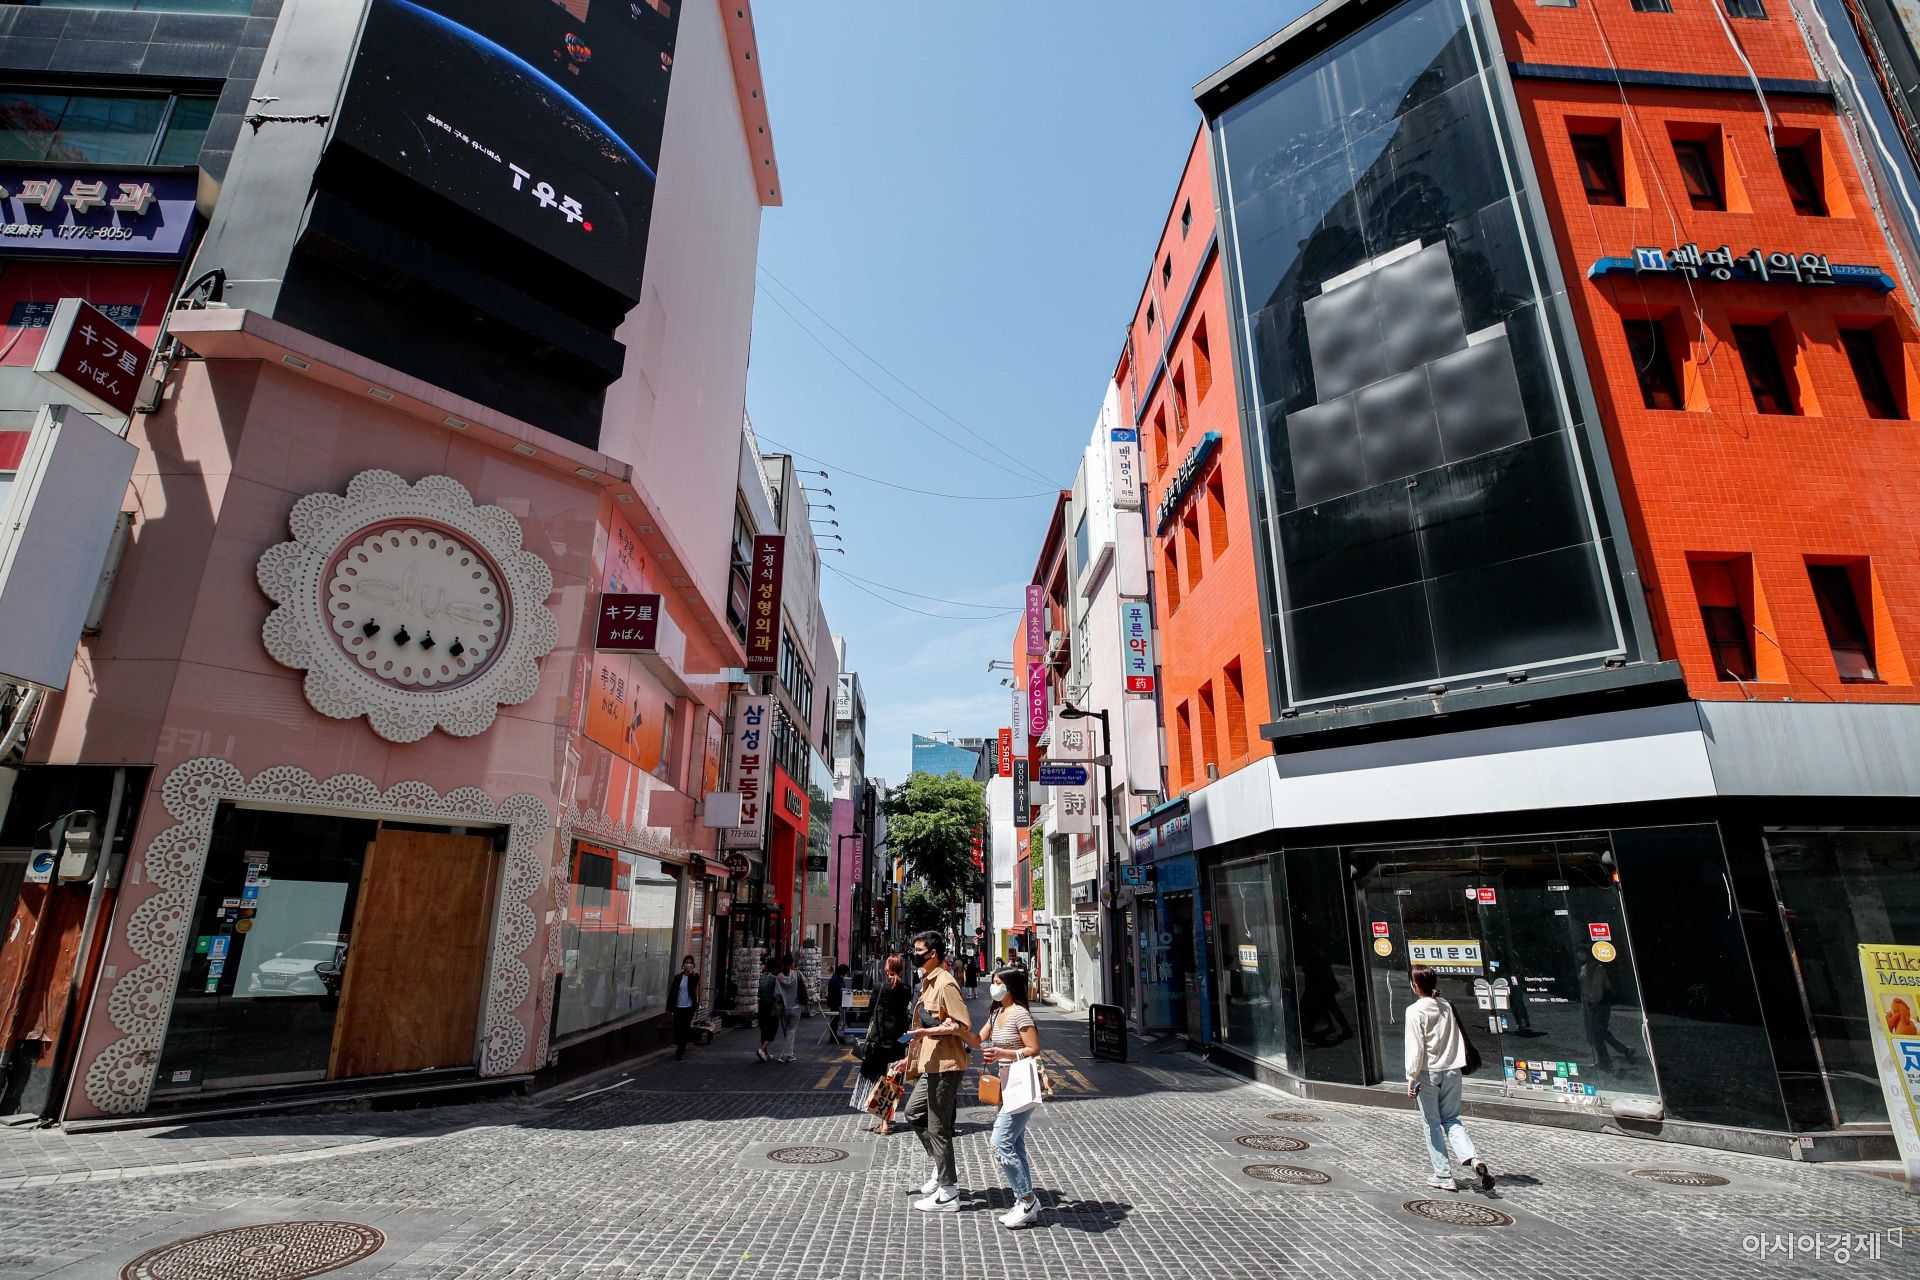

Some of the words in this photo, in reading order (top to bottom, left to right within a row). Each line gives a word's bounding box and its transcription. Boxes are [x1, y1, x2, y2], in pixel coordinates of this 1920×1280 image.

[471, 141, 502, 163] 유니버스
[508, 162, 531, 191] T
[15, 179, 157, 215] 피부과
[57, 224, 133, 239] T.774-8050
[1664, 242, 1836, 284] 백명기의원
[79, 324, 139, 377] キラ星
[77, 359, 120, 395] かばん
[1119, 445, 1133, 489] 백명기
[760, 543, 777, 581] 노정식
[605, 605, 653, 621] キラ星
[754, 583, 773, 652] 성형외과
[610, 628, 645, 641] かばん
[1129, 608, 1148, 673] 푸른약국
[730, 829, 758, 839] 773-6622
[1126, 866, 1143, 884] 약
[1413, 947, 1478, 959] 임대문의
[1430, 966, 1475, 974] -5318-3412
